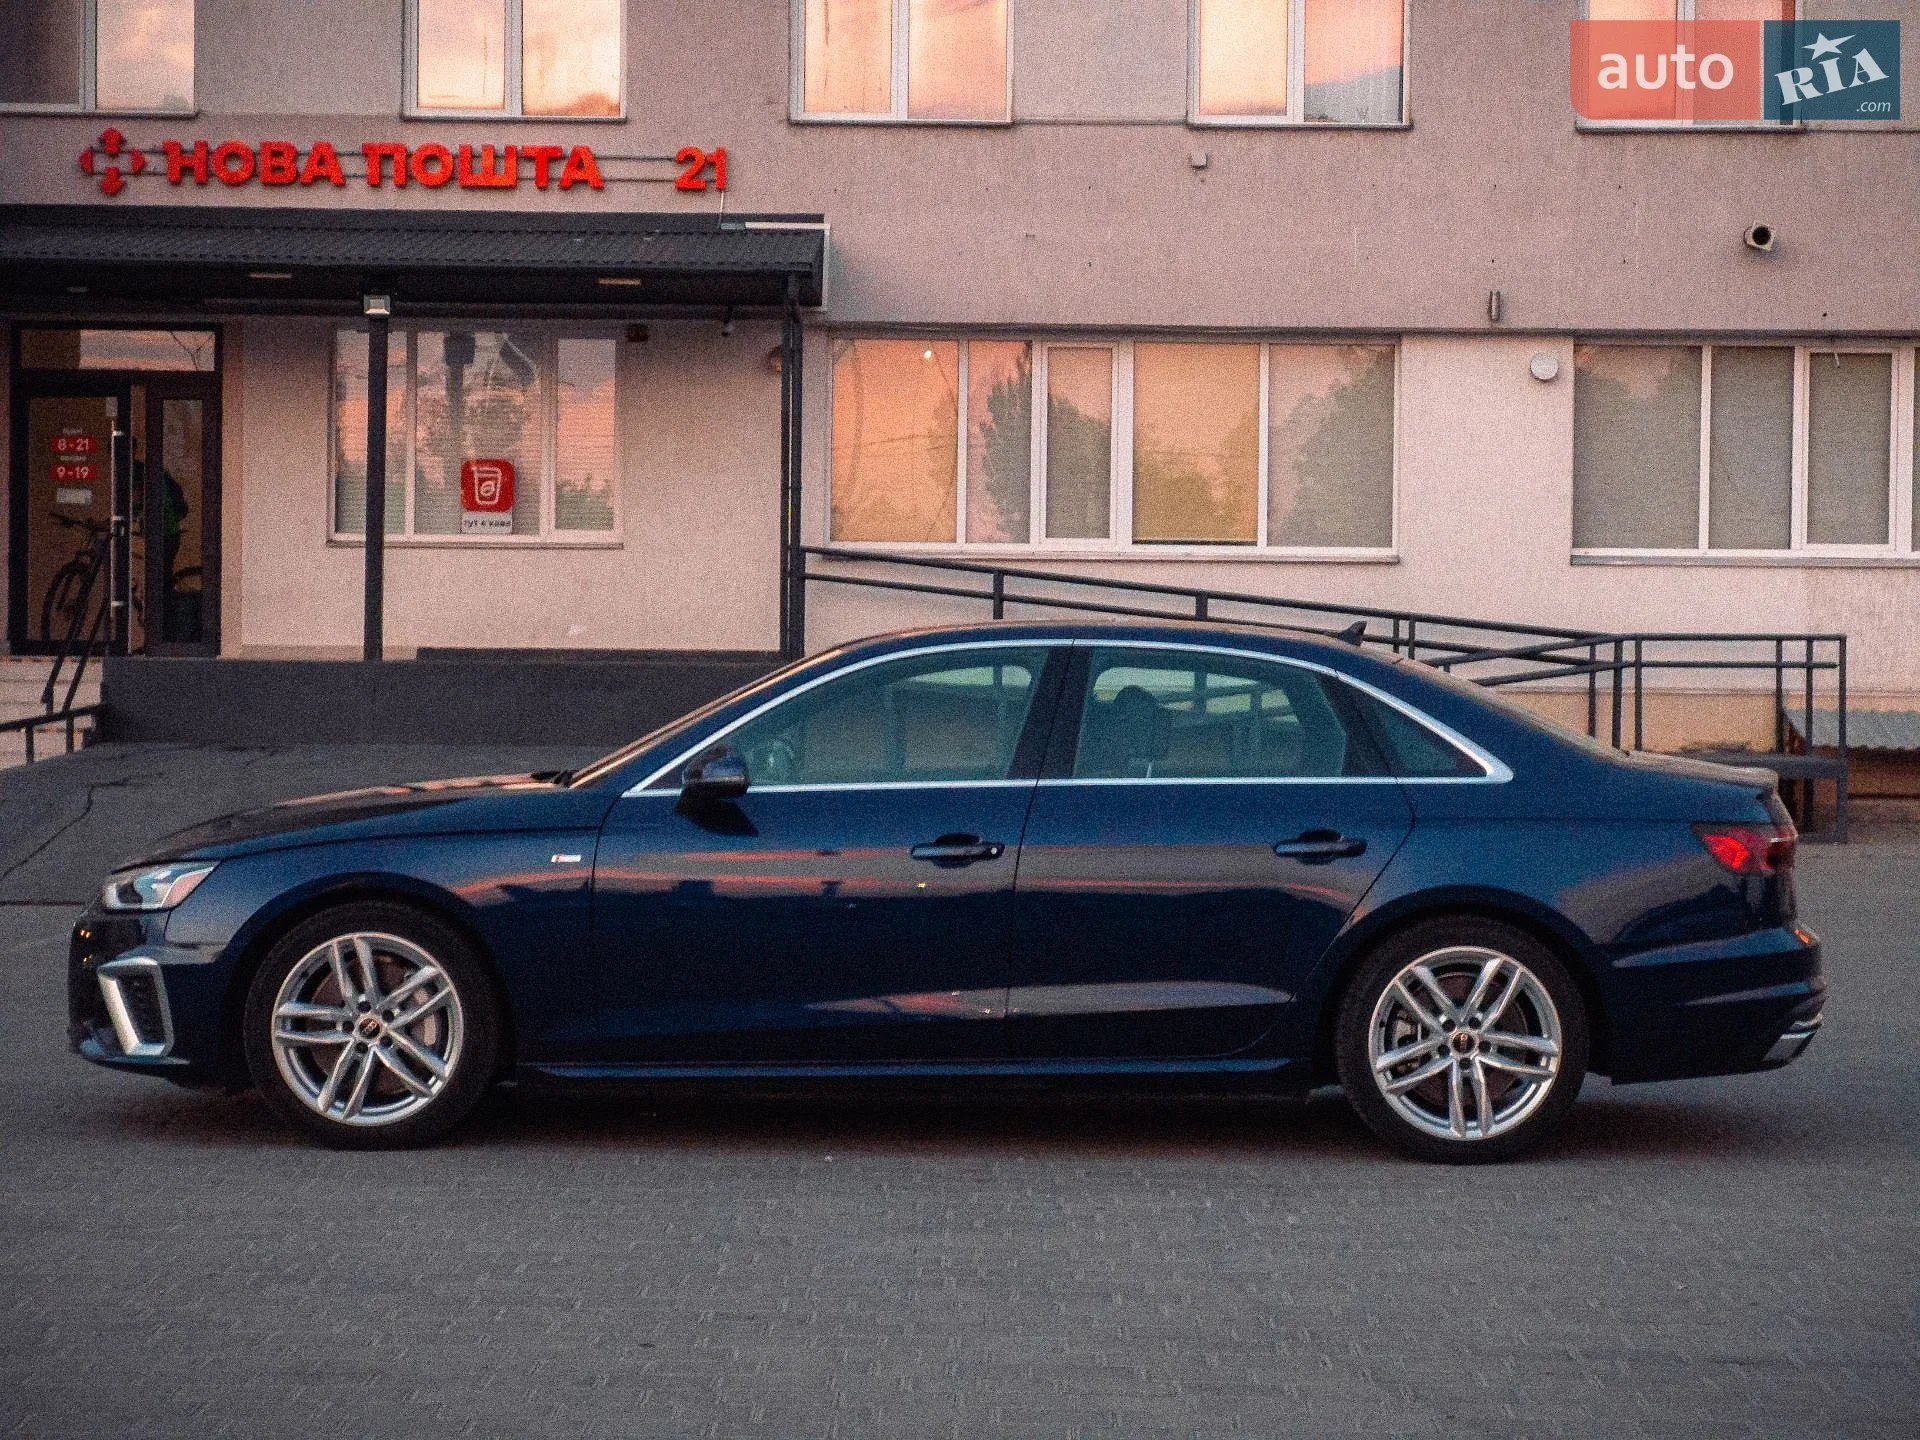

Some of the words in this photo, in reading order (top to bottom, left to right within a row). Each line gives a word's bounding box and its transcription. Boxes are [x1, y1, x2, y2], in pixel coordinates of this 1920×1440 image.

[162, 139, 346, 186] НОВА
[361, 143, 604, 190] ПОШТА
[674, 146, 727, 191] 21
